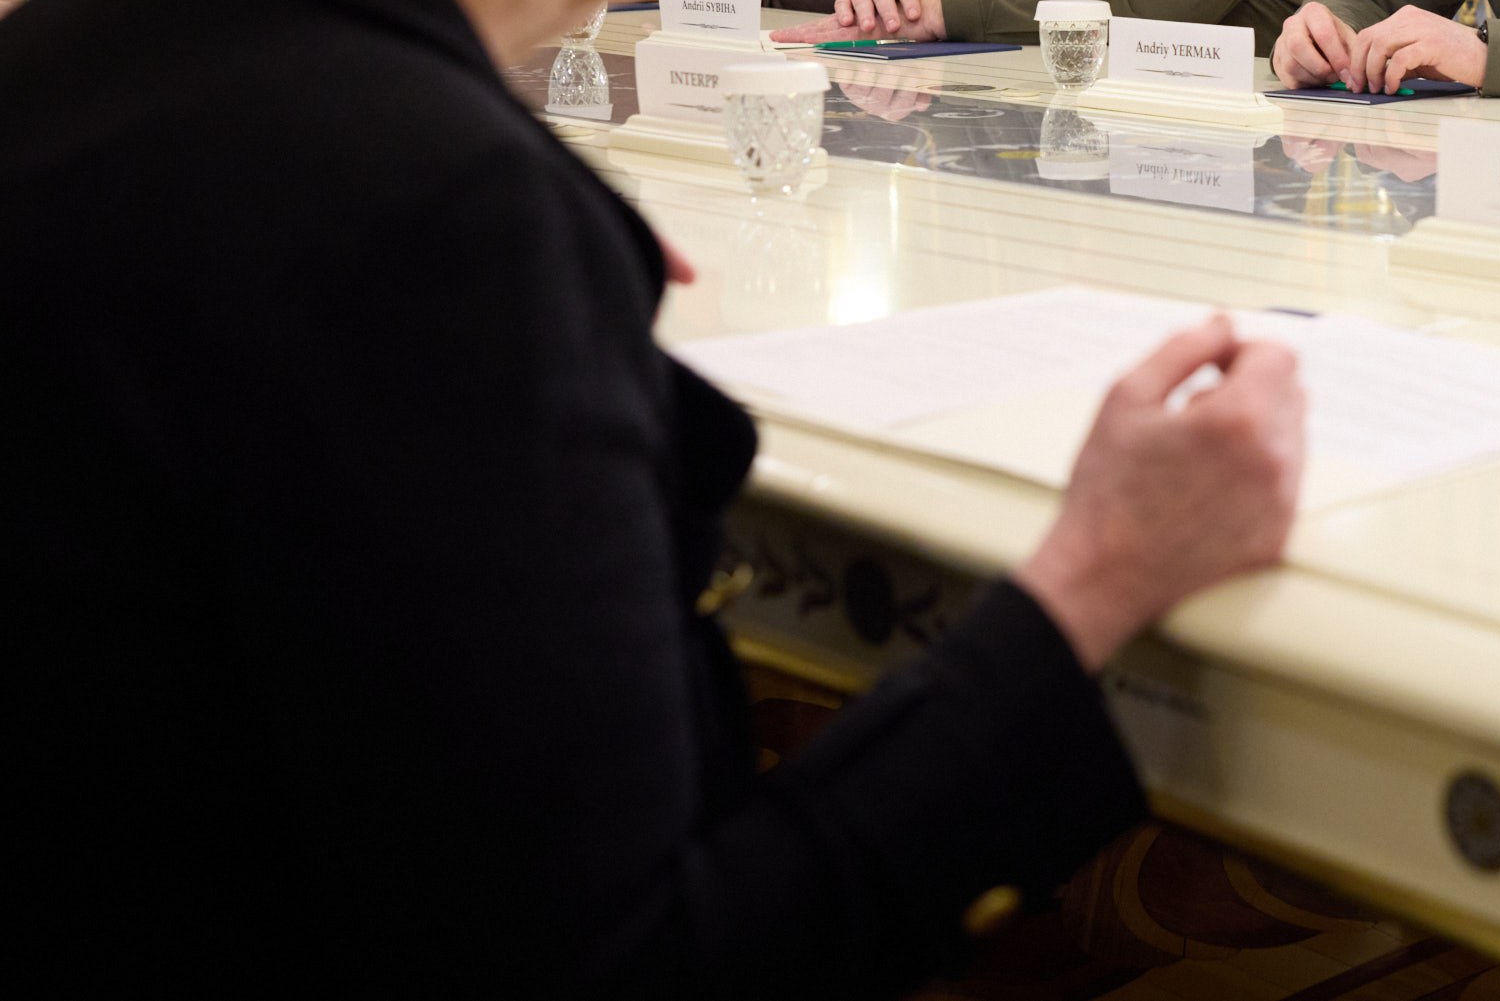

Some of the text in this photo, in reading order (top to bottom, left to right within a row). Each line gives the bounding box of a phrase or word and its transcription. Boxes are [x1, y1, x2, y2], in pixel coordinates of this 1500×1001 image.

[682, 0, 737, 14] Andrii SYBIHA
[1136, 40, 1221, 60] Andriy YERMAK
